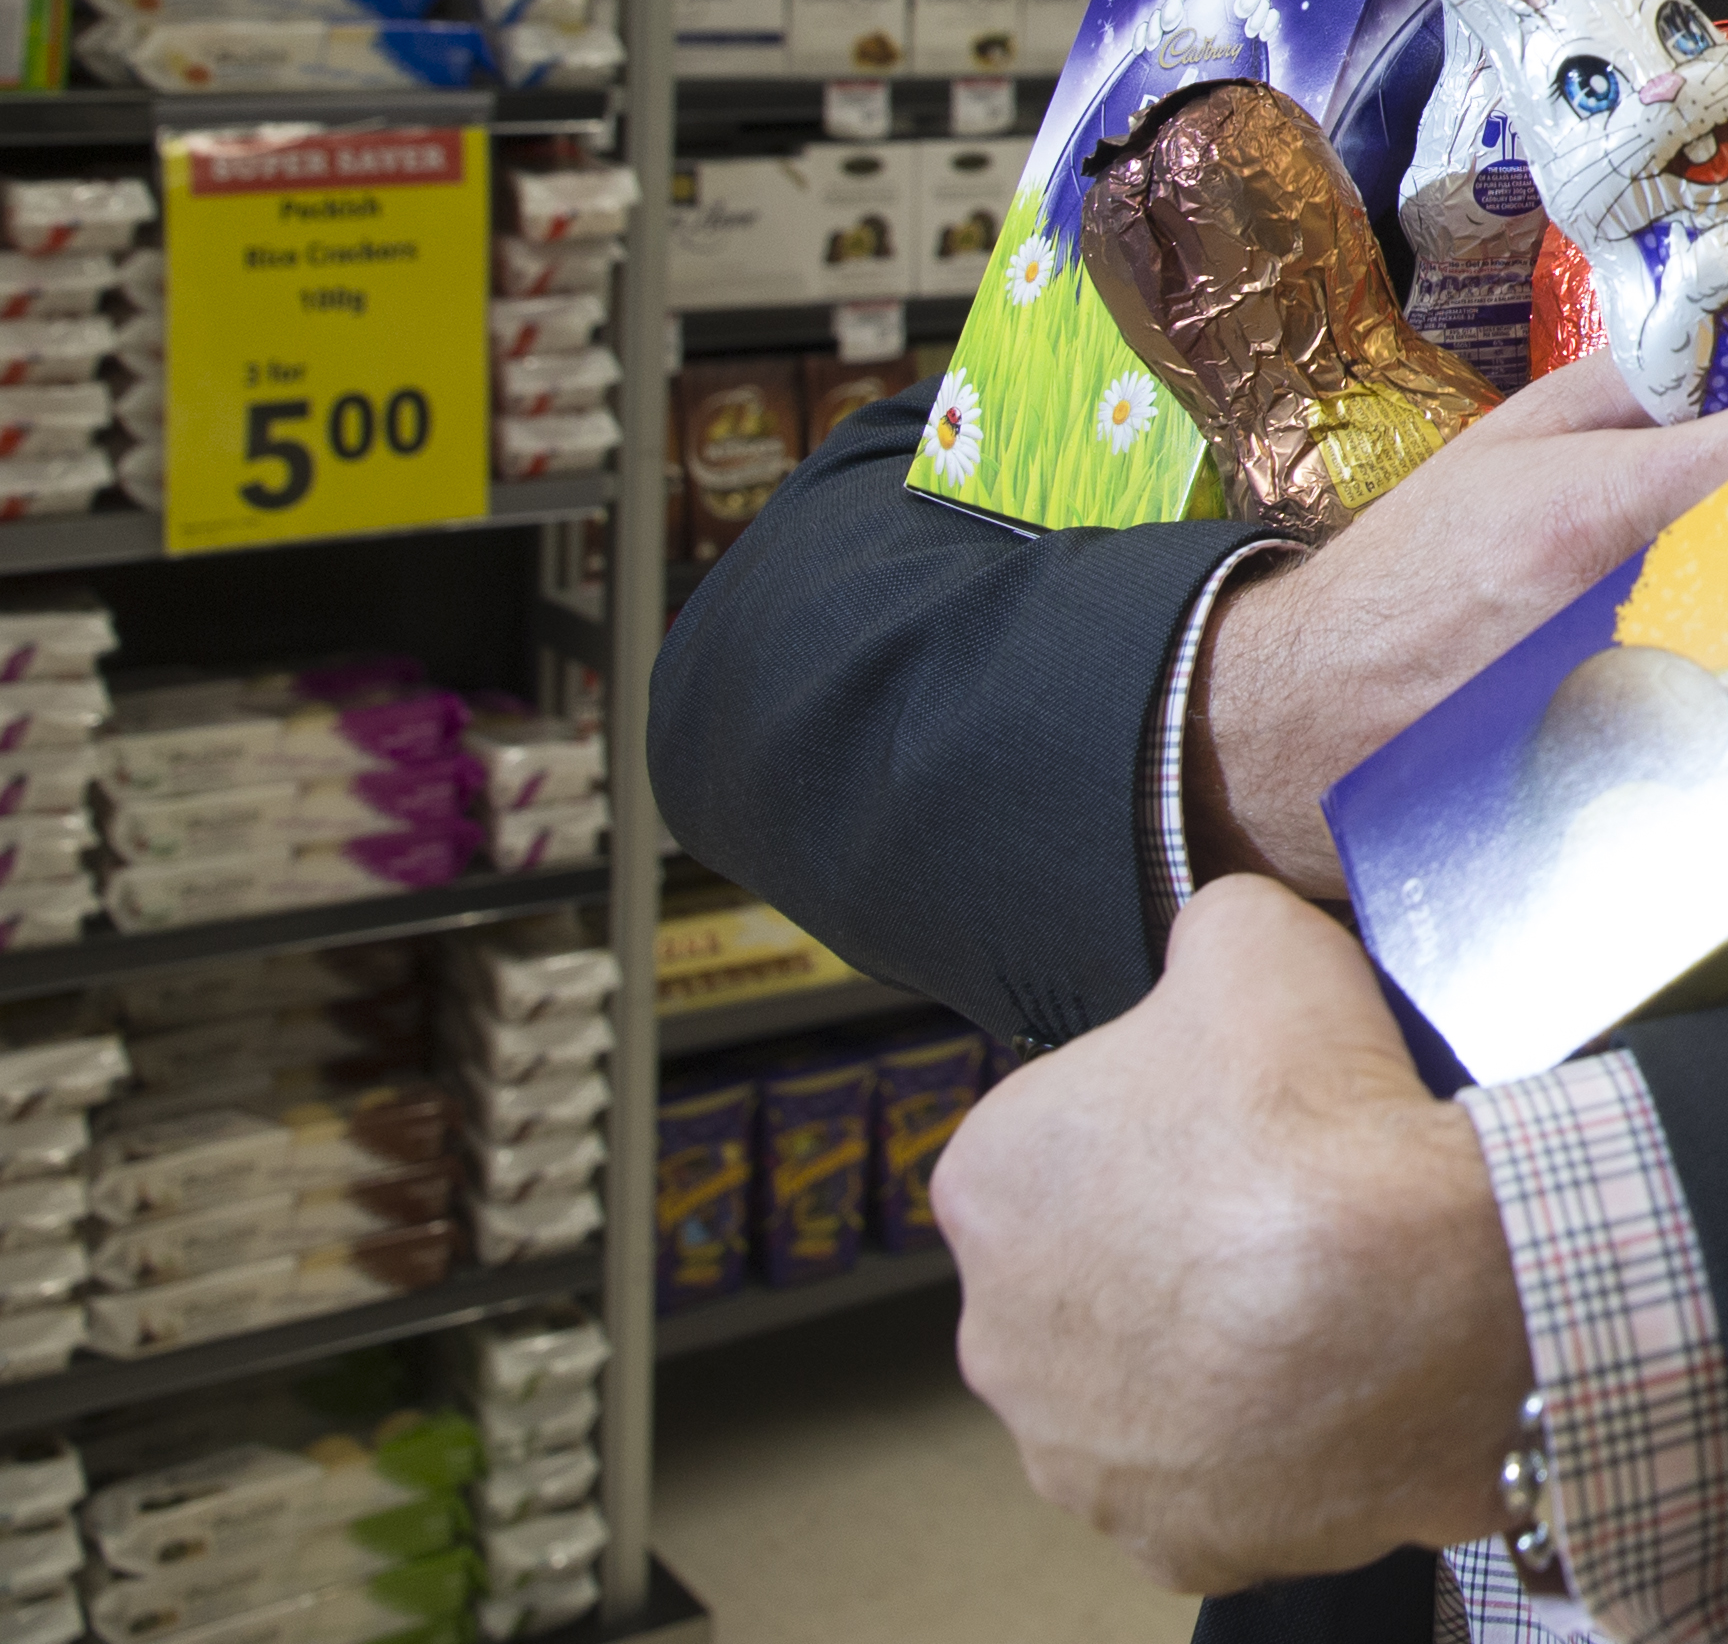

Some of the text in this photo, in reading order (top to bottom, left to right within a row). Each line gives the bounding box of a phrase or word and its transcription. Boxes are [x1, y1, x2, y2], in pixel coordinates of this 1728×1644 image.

[1158, 27, 1244, 70] Cadbury
[212, 144, 447, 182] SUPER SAVER
[1501, 202, 1536, 210] CHOCOLATE
[238, 396, 318, 512] 5
